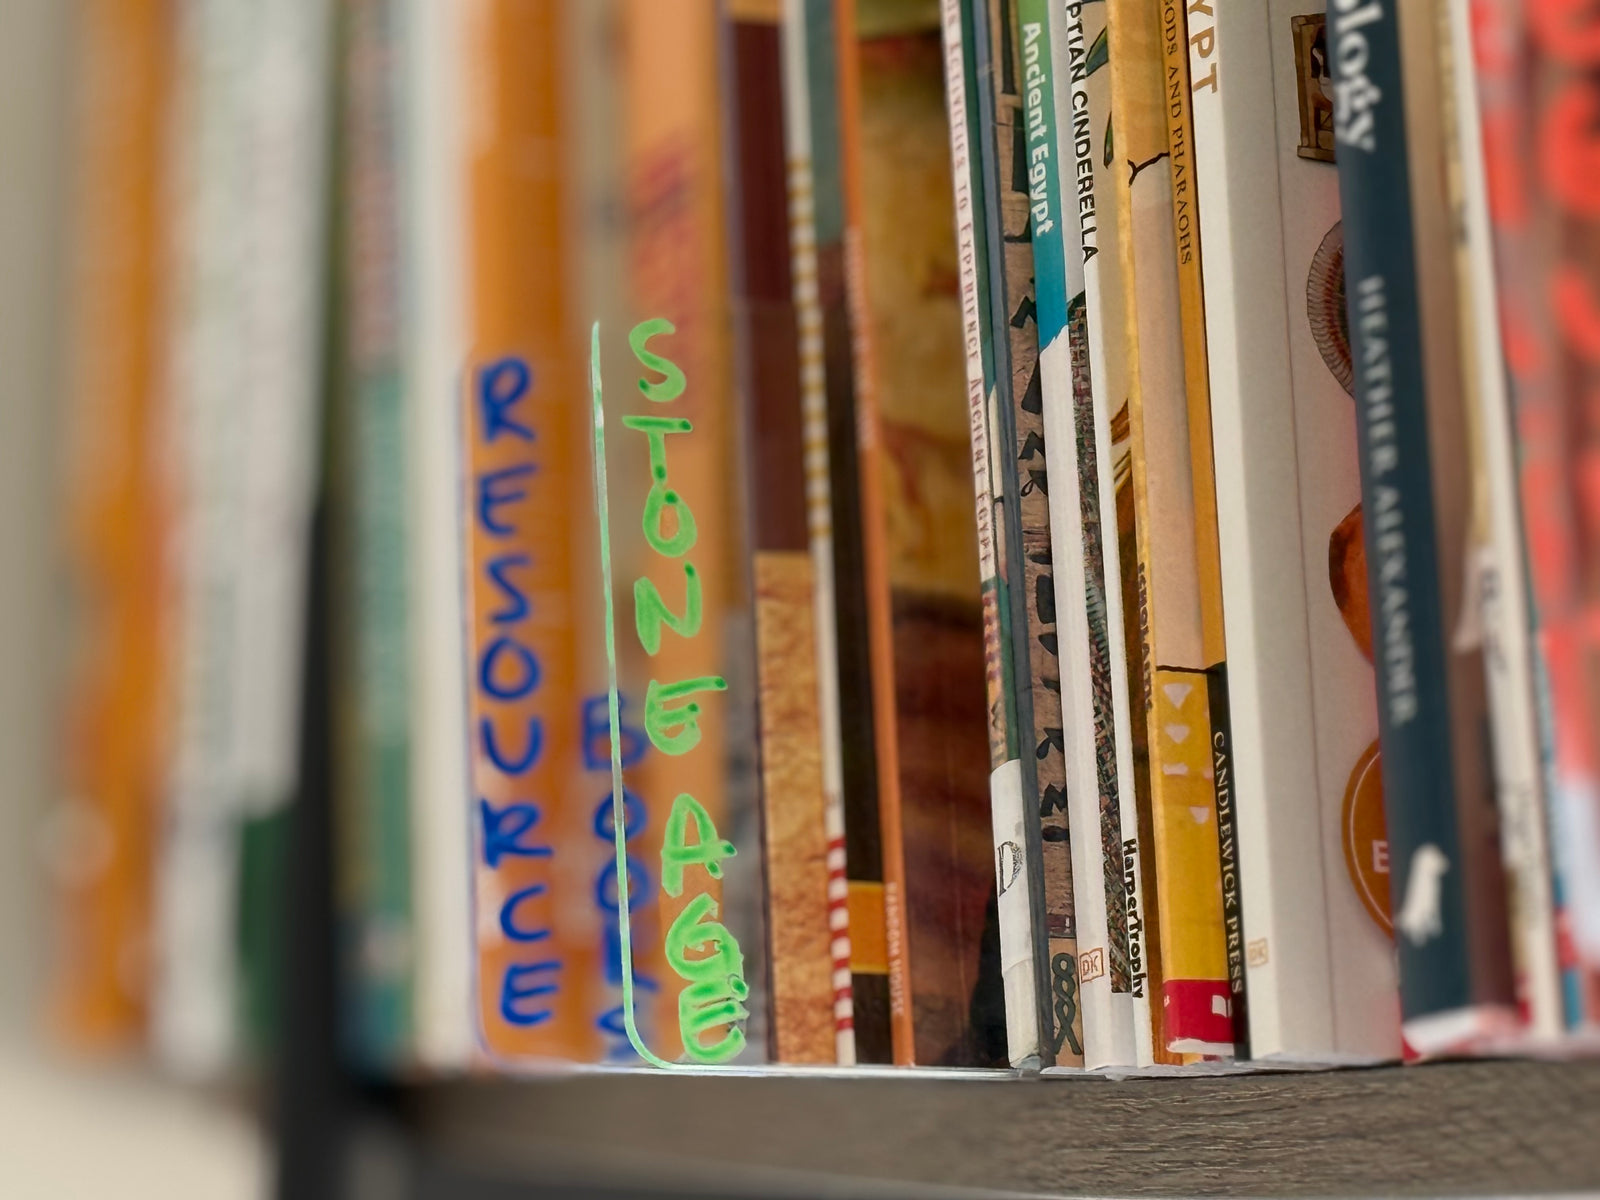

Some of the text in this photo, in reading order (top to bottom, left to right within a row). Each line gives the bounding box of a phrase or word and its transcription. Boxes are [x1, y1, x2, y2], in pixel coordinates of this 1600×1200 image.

[1022, 22, 1055, 238] Ancient Egypt
[1065, 1, 1099, 264] PTIAN CINDERELLA
[1169, 66, 1183, 120] AND
[957, 183, 970, 210] TO
[1171, 125, 1193, 266] PHARAOHS
[959, 220, 979, 361] EXPERIENCE
[969, 376, 988, 477] ANCIENT
[976, 491, 993, 564] EGYPT
[477, 355, 565, 1028] RESOURCE
[621, 317, 750, 1063] STONE AGE
[1122, 837, 1149, 1000] HarperTrophy
[1213, 730, 1242, 994] CANDLEWICK PRESS
